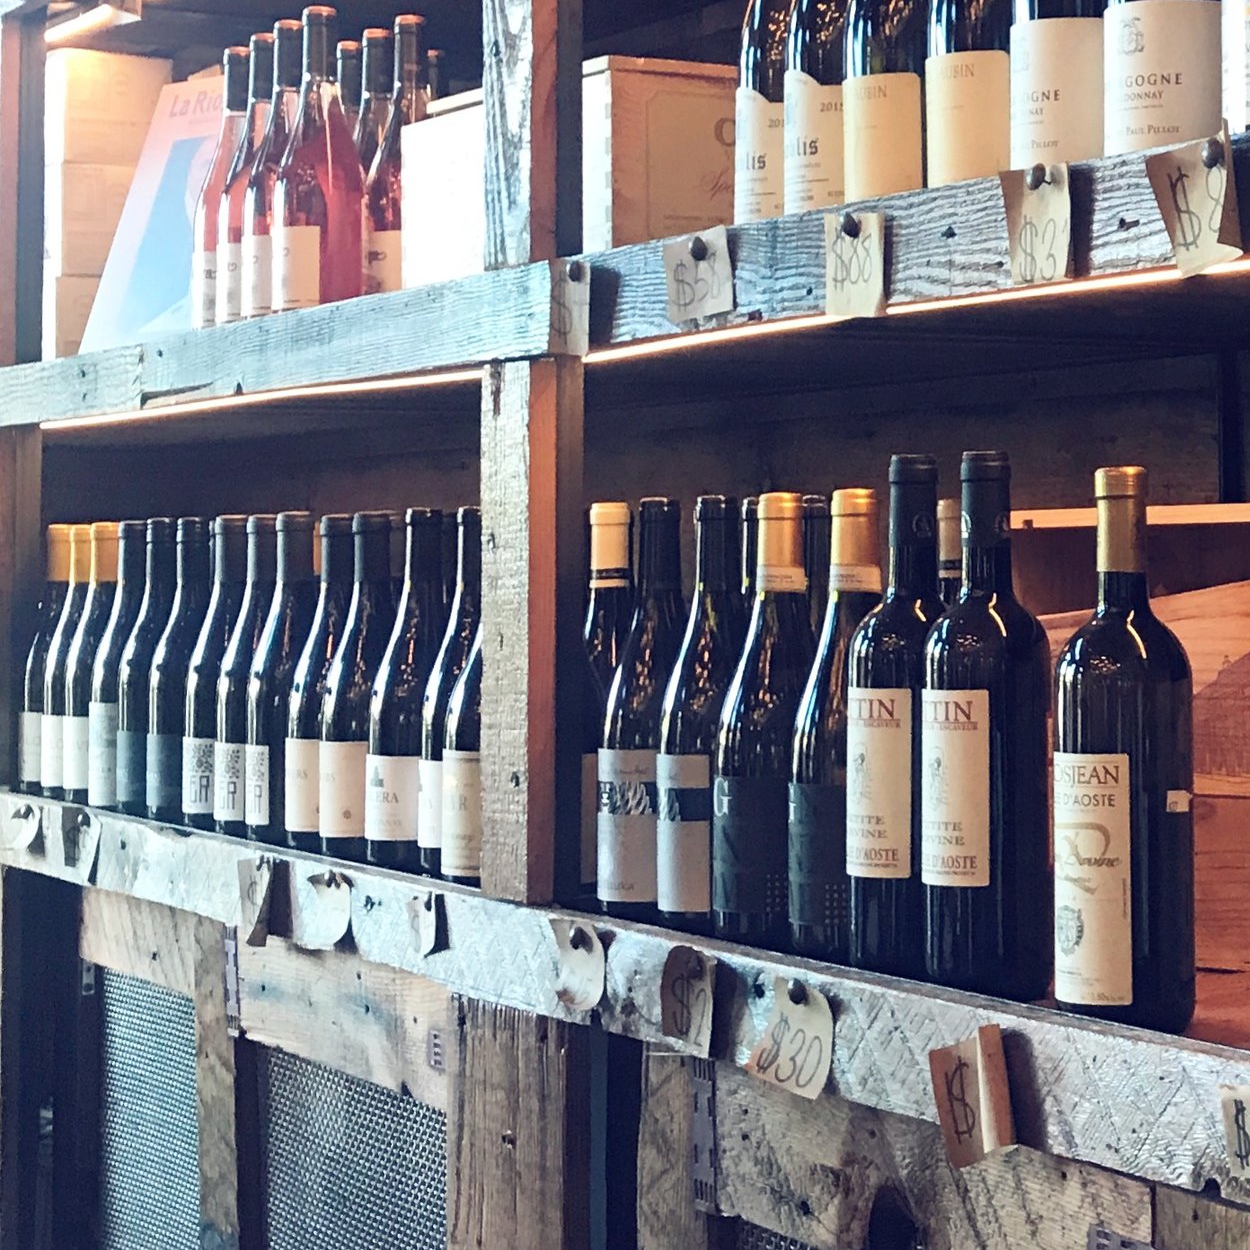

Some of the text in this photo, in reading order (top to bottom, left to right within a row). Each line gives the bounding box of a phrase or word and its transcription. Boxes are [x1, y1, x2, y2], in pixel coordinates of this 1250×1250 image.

[168, 94, 191, 118] La
[755, 1011, 823, 1089] $30
[944, 1055, 976, 1145] $
